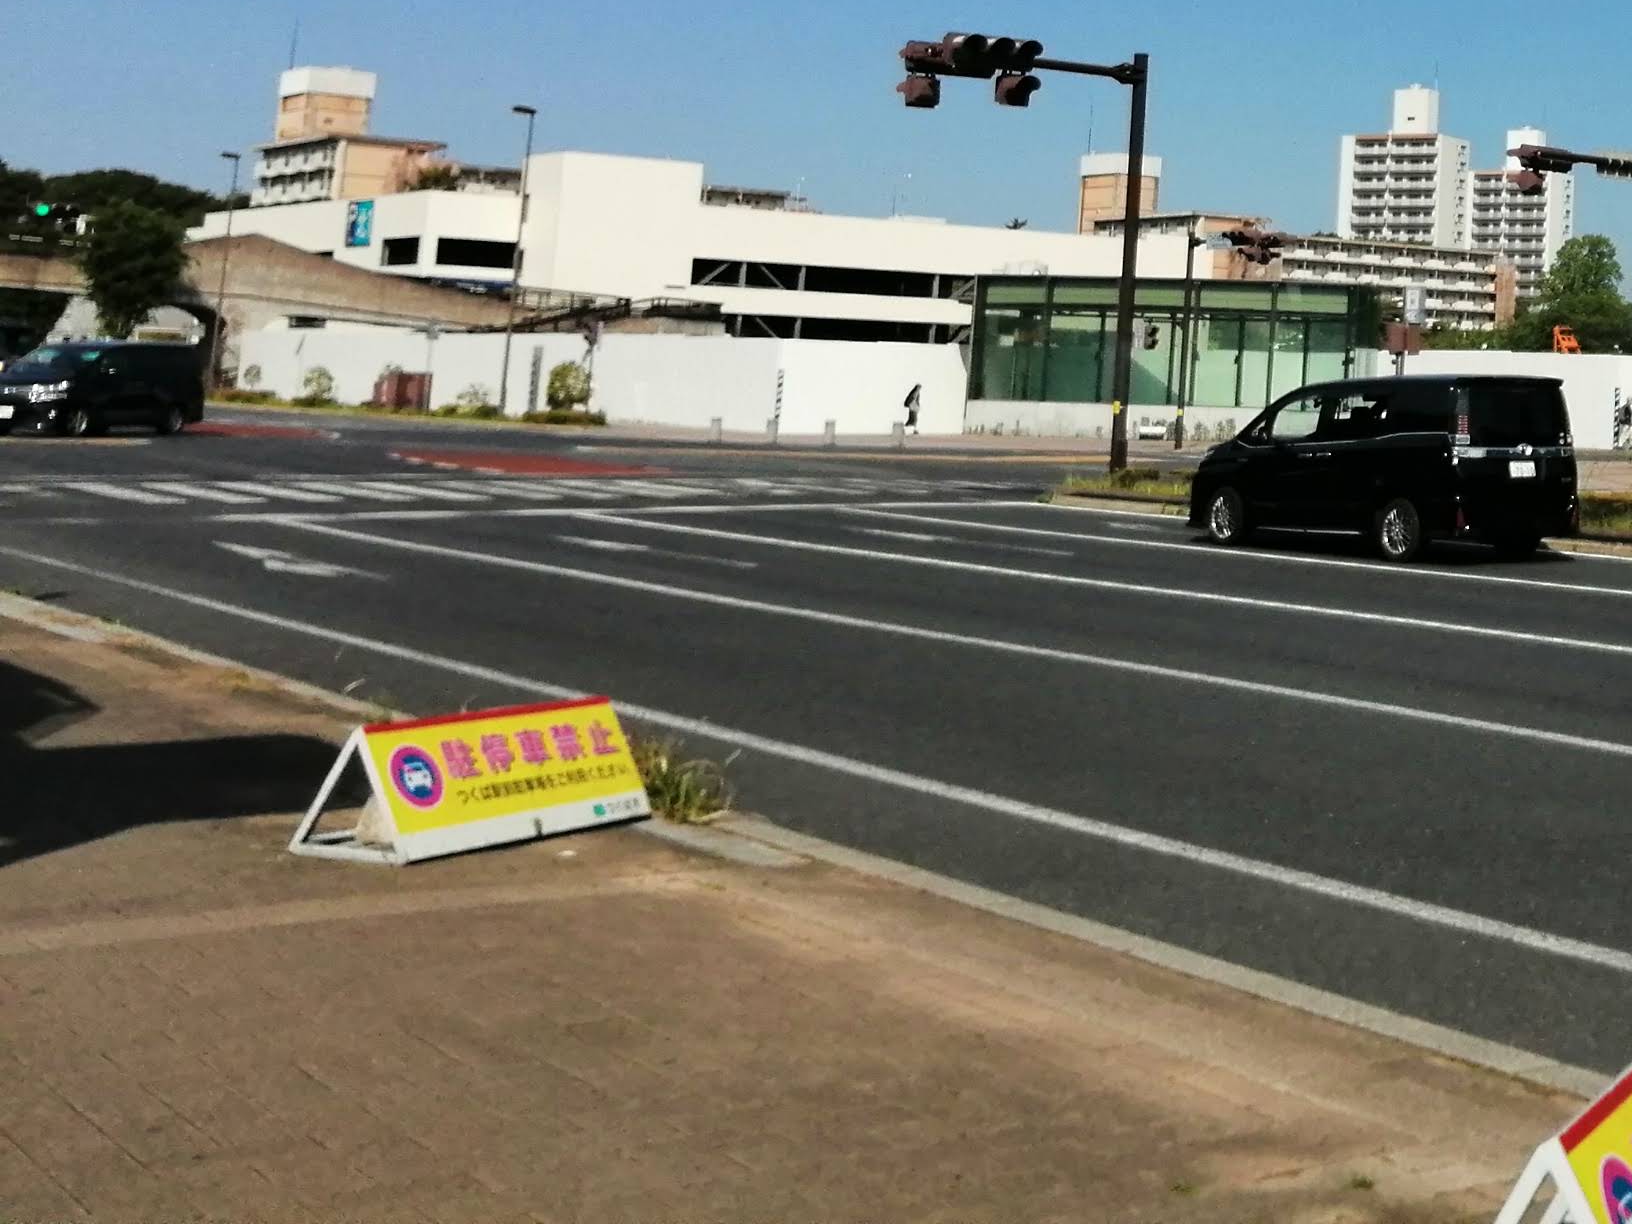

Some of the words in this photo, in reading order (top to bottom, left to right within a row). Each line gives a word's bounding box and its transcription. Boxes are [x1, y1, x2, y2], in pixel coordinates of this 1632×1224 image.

[441, 720, 620, 779] 駐停車禁止
